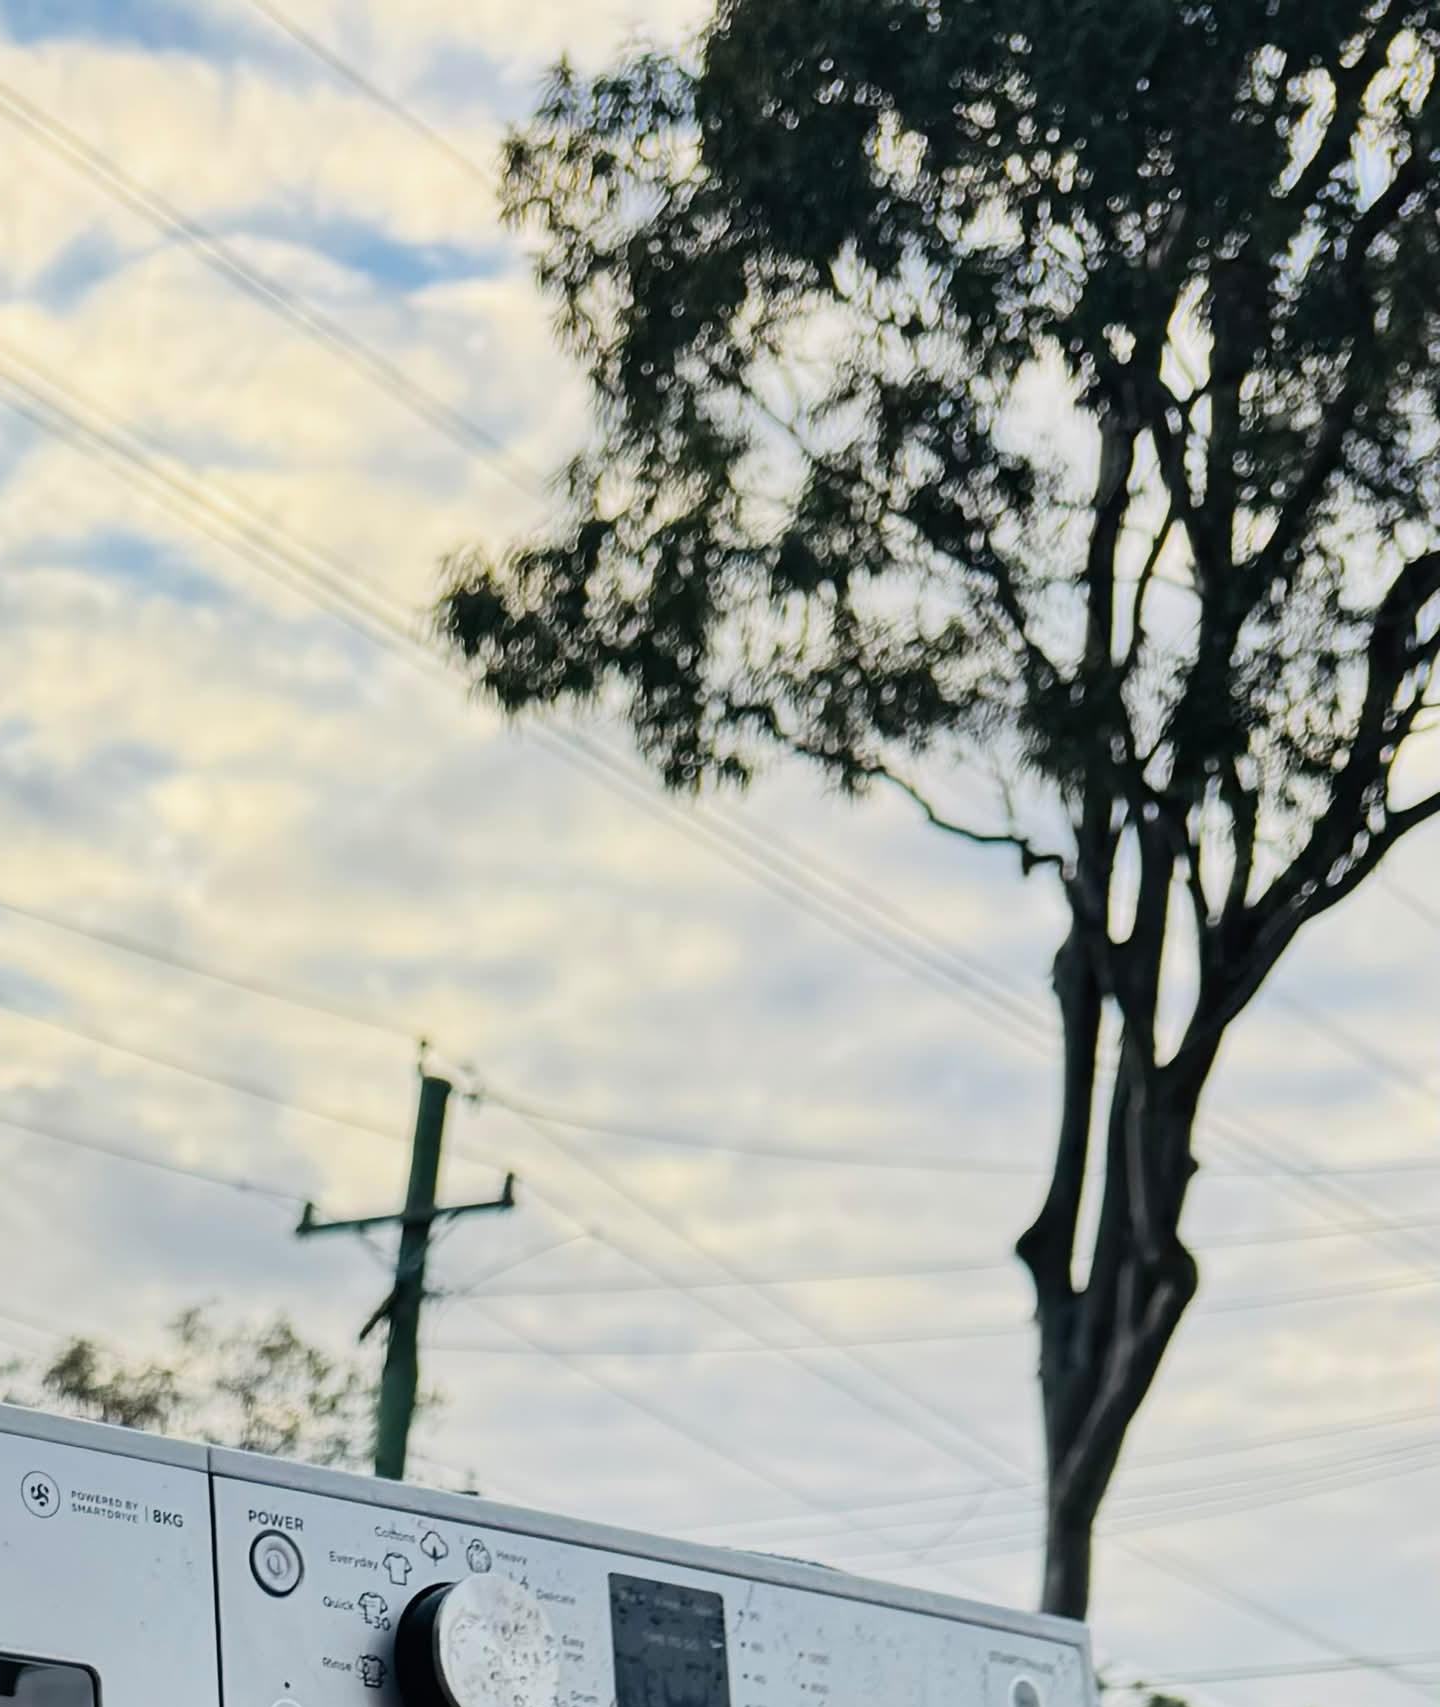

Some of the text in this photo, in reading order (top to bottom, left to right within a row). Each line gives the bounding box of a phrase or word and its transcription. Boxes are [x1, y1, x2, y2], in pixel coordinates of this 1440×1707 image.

[71, 1490, 139, 1511] POWERED BY
[71, 1503, 139, 1524] SMARTDRIVE
[152, 1508, 184, 1528] 8KG
[248, 1509, 304, 1532] POWER
[328, 1550, 379, 1571] Everyday
[322, 1595, 355, 1611] Quick
[322, 1656, 352, 1672] Rinse
